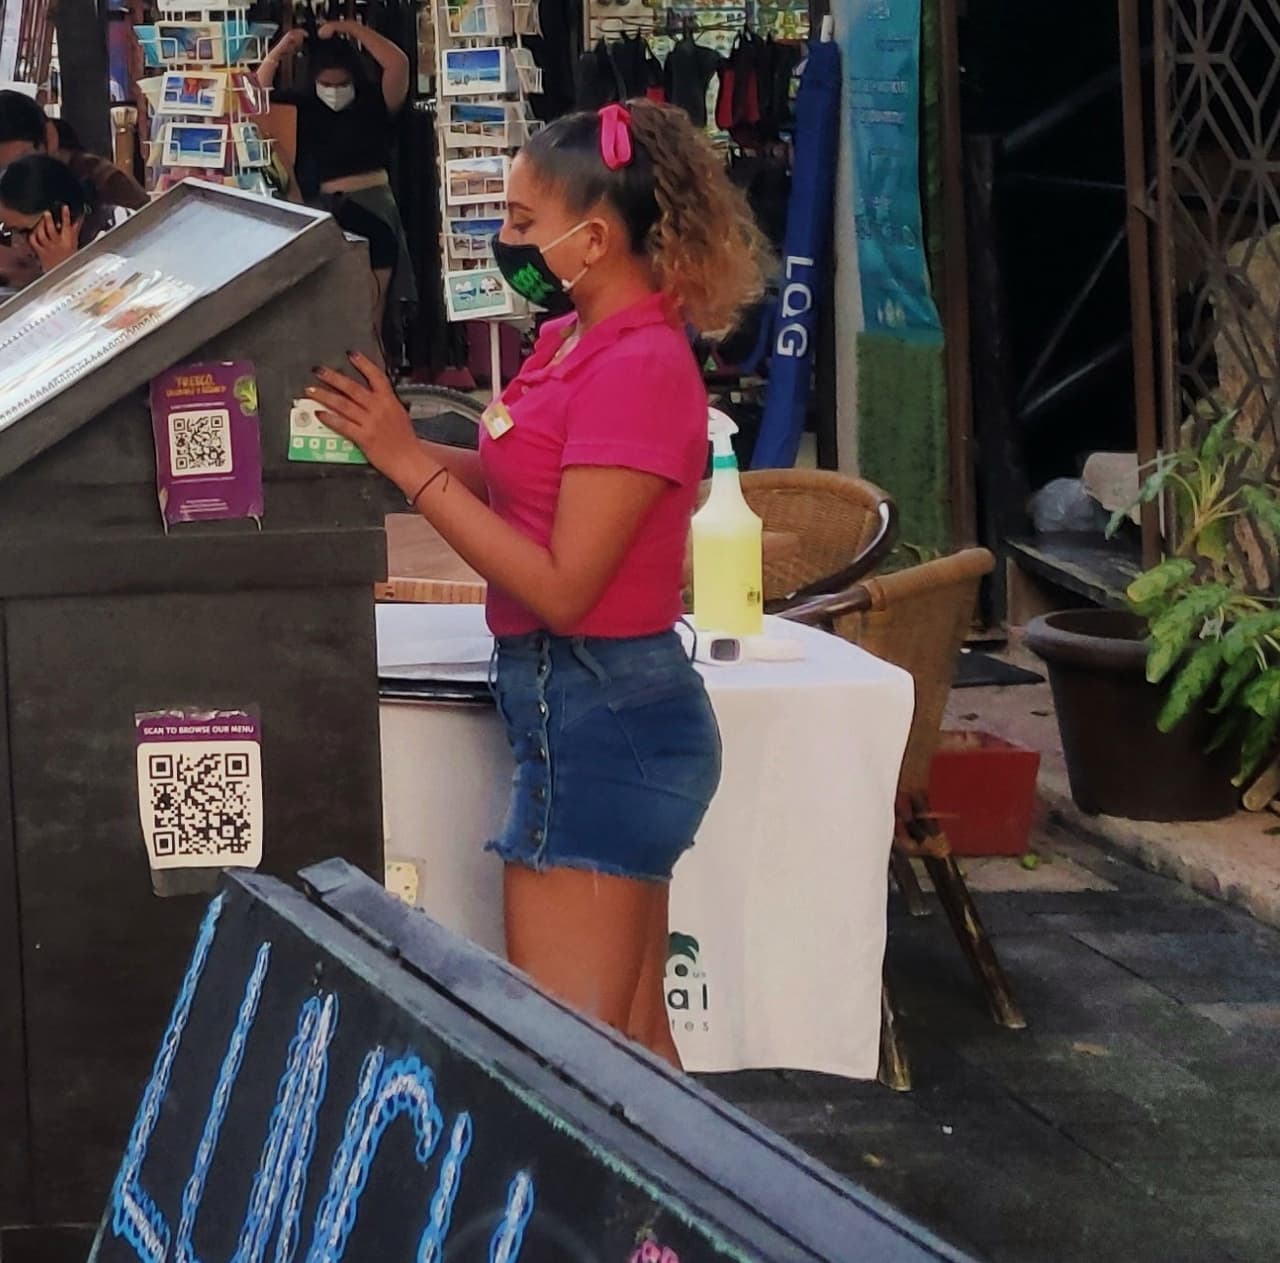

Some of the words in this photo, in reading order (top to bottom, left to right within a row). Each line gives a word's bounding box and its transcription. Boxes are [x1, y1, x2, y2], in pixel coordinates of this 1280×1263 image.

[776, 255, 814, 358] LQG
[143, 727, 164, 735] SCAN
[166, 726, 177, 734] TO
[179, 725, 210, 734] BROWSE
[212, 725, 229, 733] OUR
[231, 725, 254, 733] MENU
